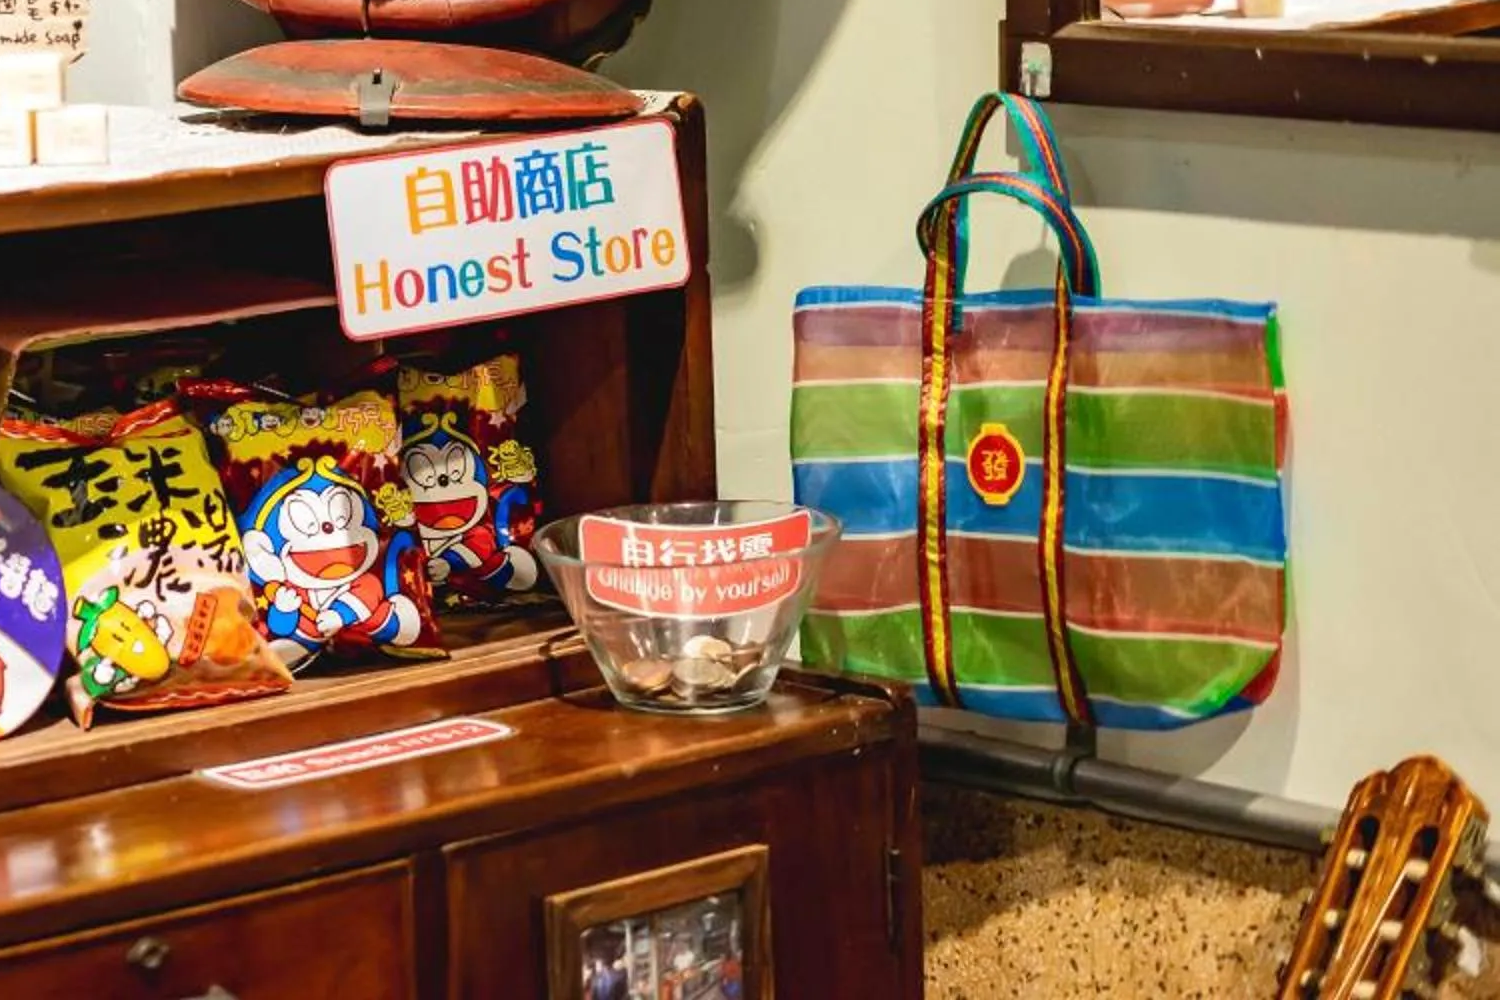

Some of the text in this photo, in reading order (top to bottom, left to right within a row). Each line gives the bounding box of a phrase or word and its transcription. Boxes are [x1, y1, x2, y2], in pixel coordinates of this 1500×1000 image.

[404, 141, 615, 235] 自助商店
[353, 225, 676, 316] Honest Store
